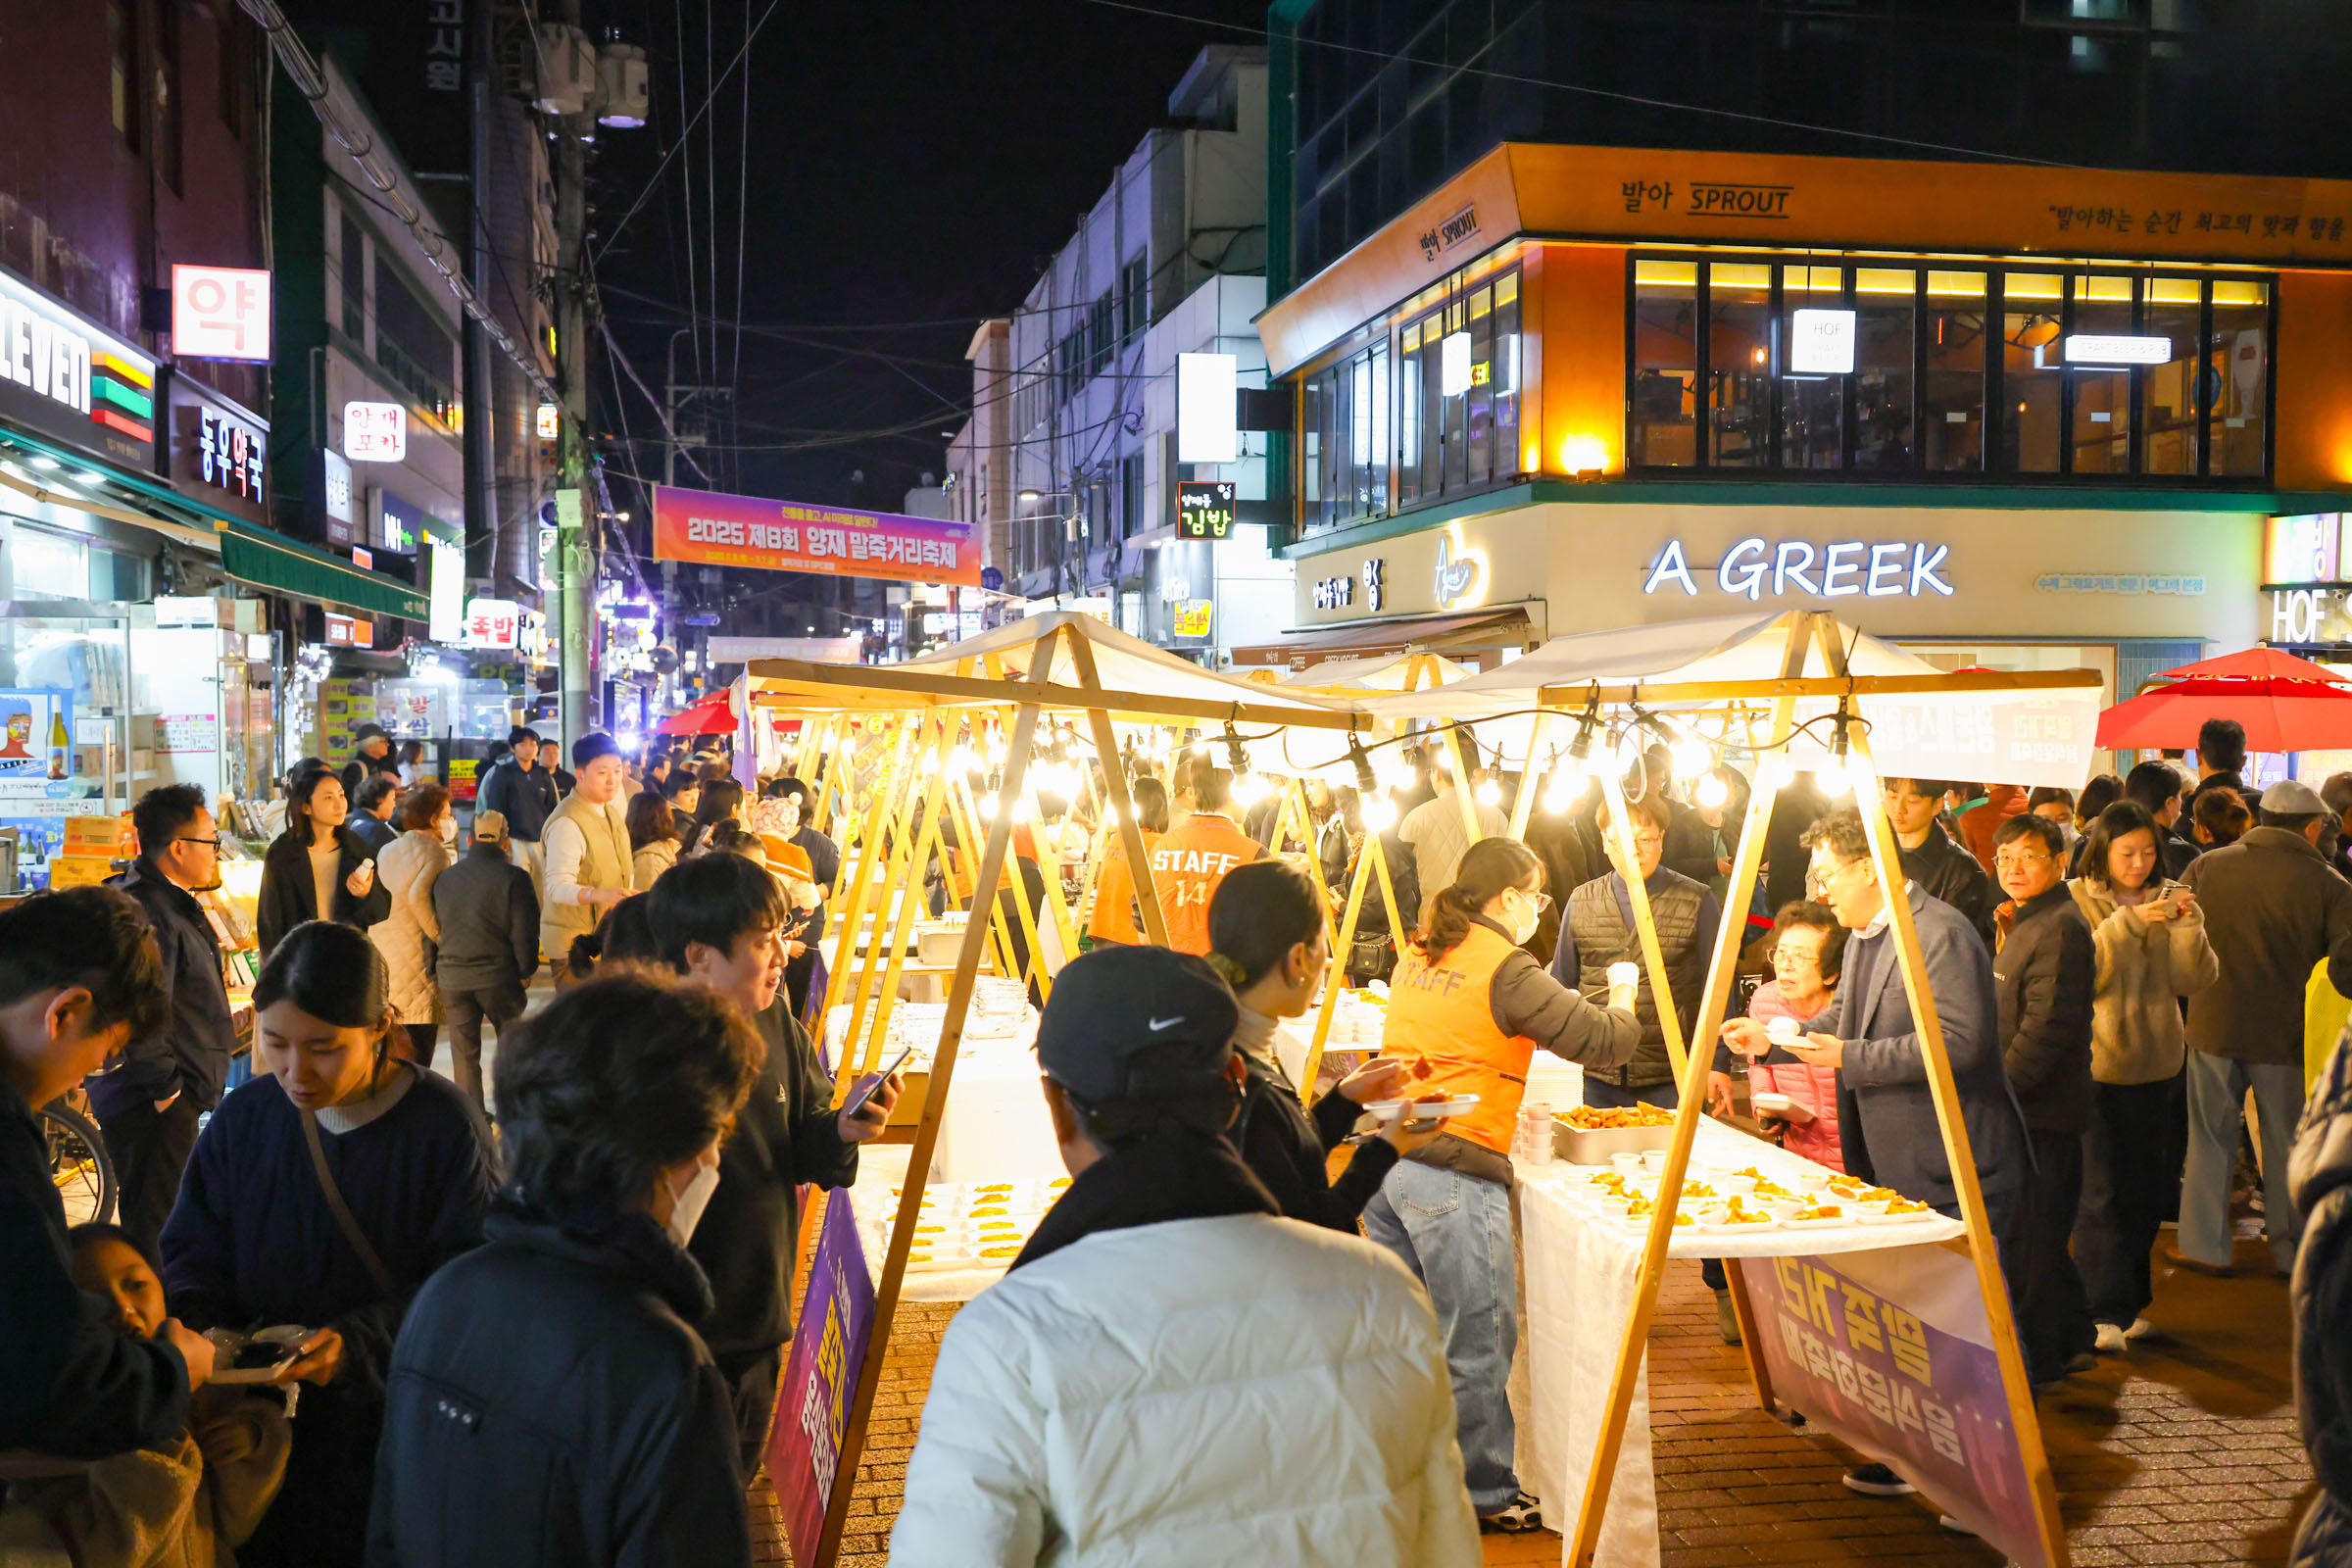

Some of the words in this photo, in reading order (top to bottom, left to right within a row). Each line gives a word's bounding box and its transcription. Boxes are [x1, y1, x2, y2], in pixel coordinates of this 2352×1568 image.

[1622, 180, 1674, 214] 발아
[1690, 188, 1790, 213] SPROUT
[1442, 209, 1477, 245] SPROUT
[2144, 210, 2182, 234] 순간
[2195, 211, 2252, 235] 최고의
[2263, 214, 2299, 239] 맛과
[2309, 216, 2345, 241] 향을
[187, 277, 257, 352] 약
[1813, 322, 1842, 336] HOF
[352, 407, 398, 429] 양재
[200, 405, 264, 504] 동우약국
[1181, 493, 1212, 509] 양재동
[383, 511, 399, 546] NH
[1181, 509, 1232, 536] 김밥
[687, 516, 746, 546] 2025
[748, 522, 800, 553] 제8회
[807, 525, 848, 559] 양재
[850, 530, 957, 569] 말죽거리축제
[1643, 539, 1699, 597] A
[1718, 536, 1955, 602] GREEK
[471, 614, 514, 644] 족발
[2271, 589, 2327, 644] HOF
[1152, 850, 1241, 875] STAFF
[1175, 879, 1207, 907] 14
[1393, 966, 1467, 997] STAFF
